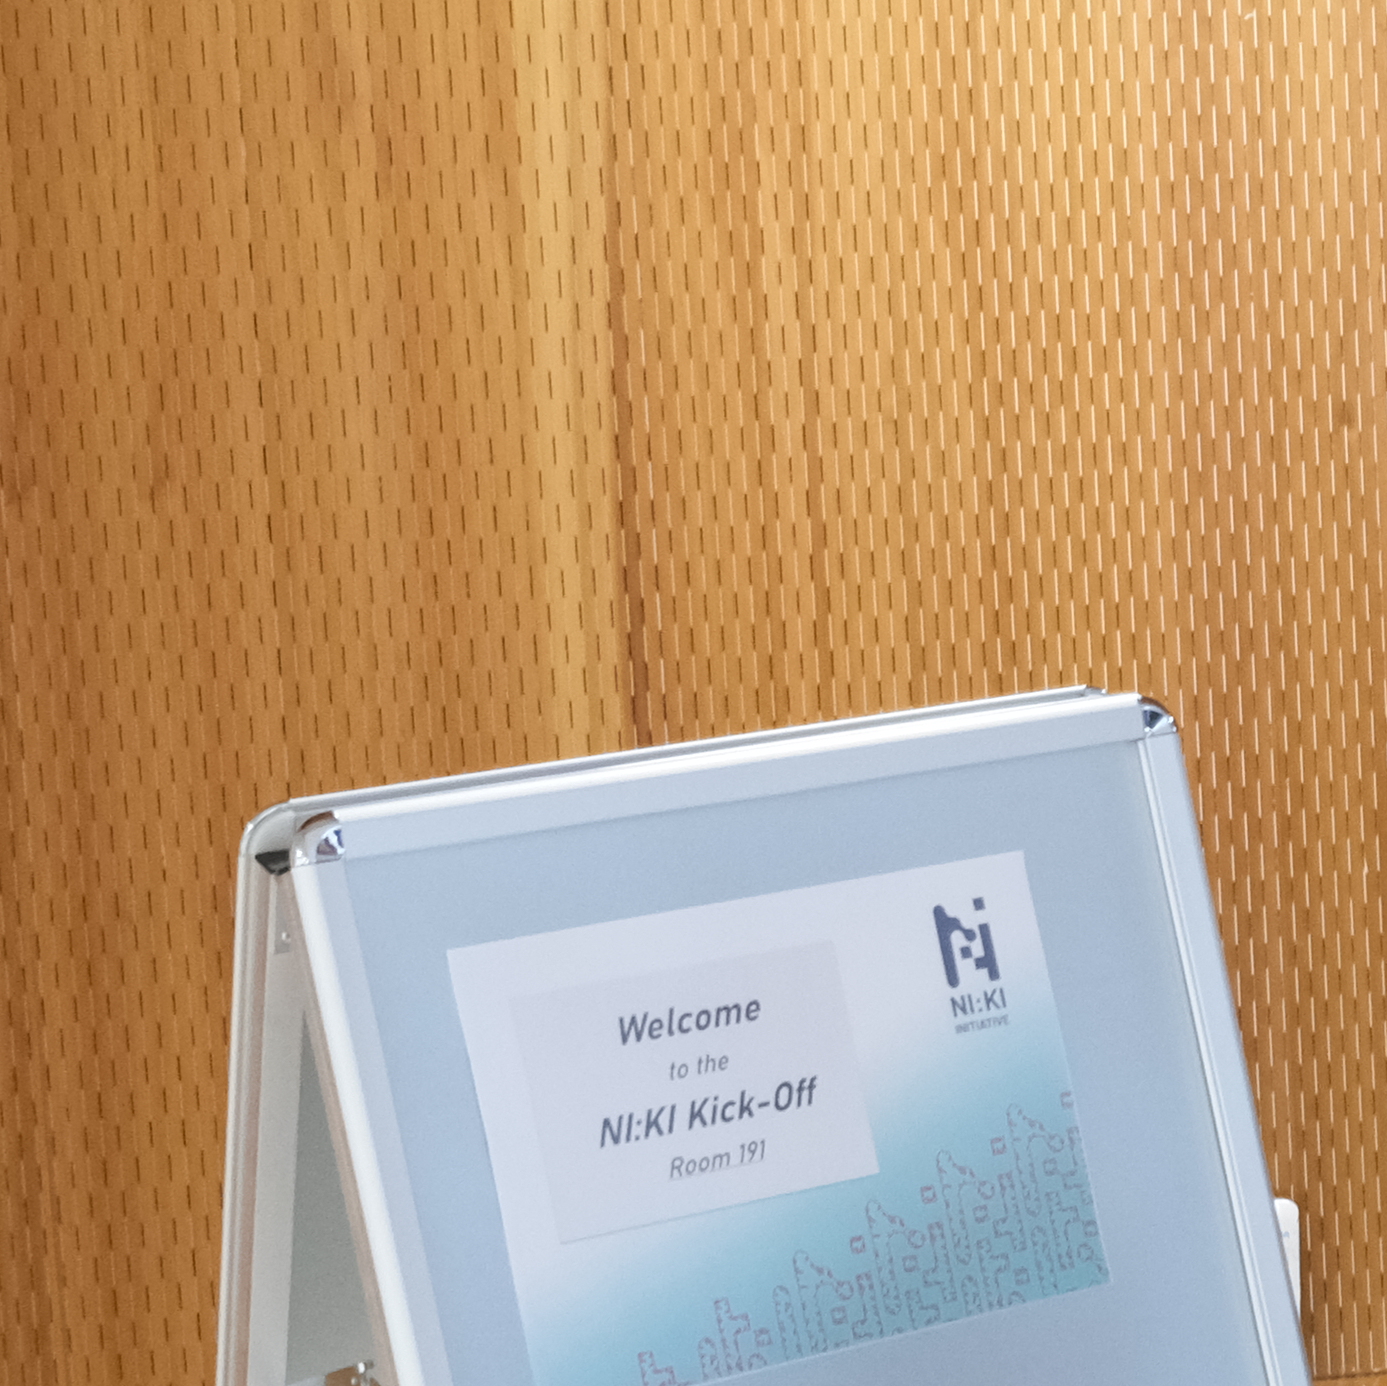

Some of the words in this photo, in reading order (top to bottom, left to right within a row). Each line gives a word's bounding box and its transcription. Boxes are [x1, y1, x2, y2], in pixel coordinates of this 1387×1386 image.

[618, 999, 762, 1046] Welcome
[949, 987, 1007, 1018] NI:KI
[669, 1061, 689, 1081] to
[697, 1054, 730, 1076] the
[600, 1103, 677, 1149] NI:KI
[688, 1075, 817, 1131] Kick-Off
[669, 1150, 731, 1180] Room
[739, 1139, 766, 1164] 191
